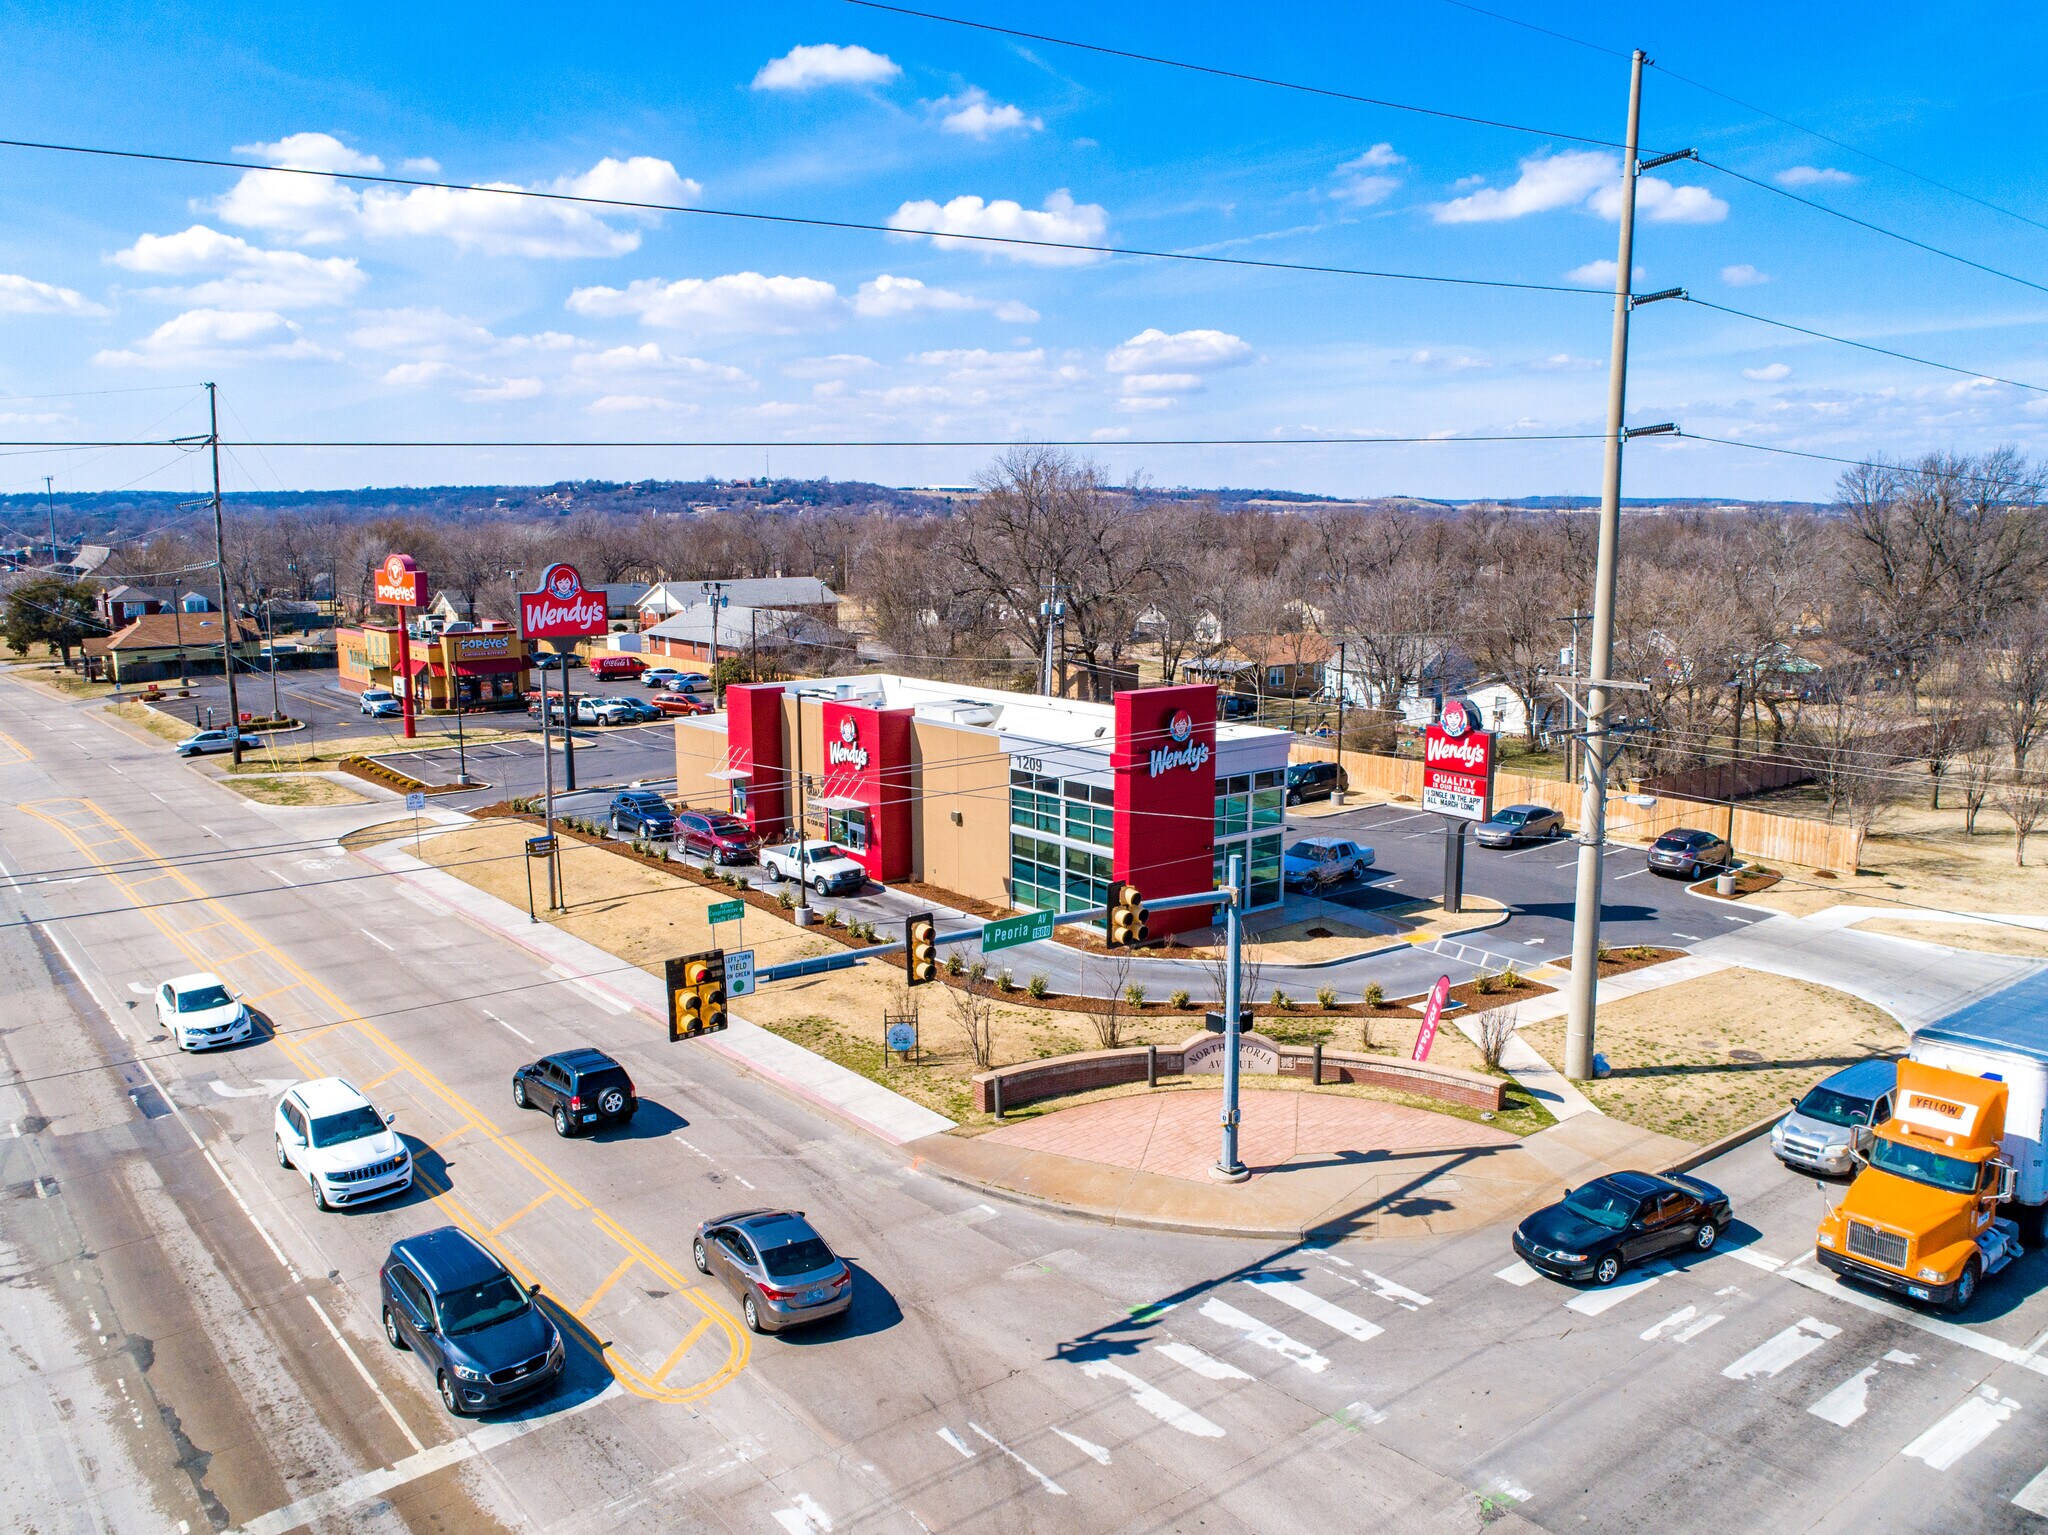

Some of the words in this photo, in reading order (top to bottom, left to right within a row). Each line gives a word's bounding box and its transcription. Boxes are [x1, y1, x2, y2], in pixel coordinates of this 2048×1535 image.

[526, 596, 604, 632] Wendy's
[830, 741, 868, 770] Wendy's
[1150, 739, 1209, 778] Wendy's
[1427, 737, 1485, 768] Wendy's
[1017, 756, 1043, 772] 1209
[1433, 773, 1476, 789] QUALITY
[1431, 790, 1448, 799] SINGLE
[1457, 794, 1467, 803] THE
[1469, 797, 1481, 805] APP
[1453, 786, 1475, 795] RECIPE
[1427, 796, 1437, 804] ALL
[1440, 799, 1458, 808] MARCH
[1460, 803, 1475, 811] LONG
[1037, 914, 1047, 925] AV
[984, 932, 990, 943] N
[994, 923, 1029, 943] Peoria
[1033, 926, 1051, 938] 1500
[725, 956, 736, 964] LEFT
[729, 962, 747, 971] YIELD
[735, 970, 750, 979] GREEN
[1189, 1043, 1226, 1065] NORTH
[1239, 1043, 1272, 1065] EORIA
[1208, 1060, 1254, 1069] AVUE
[1916, 1097, 1958, 1115] YELLOW
